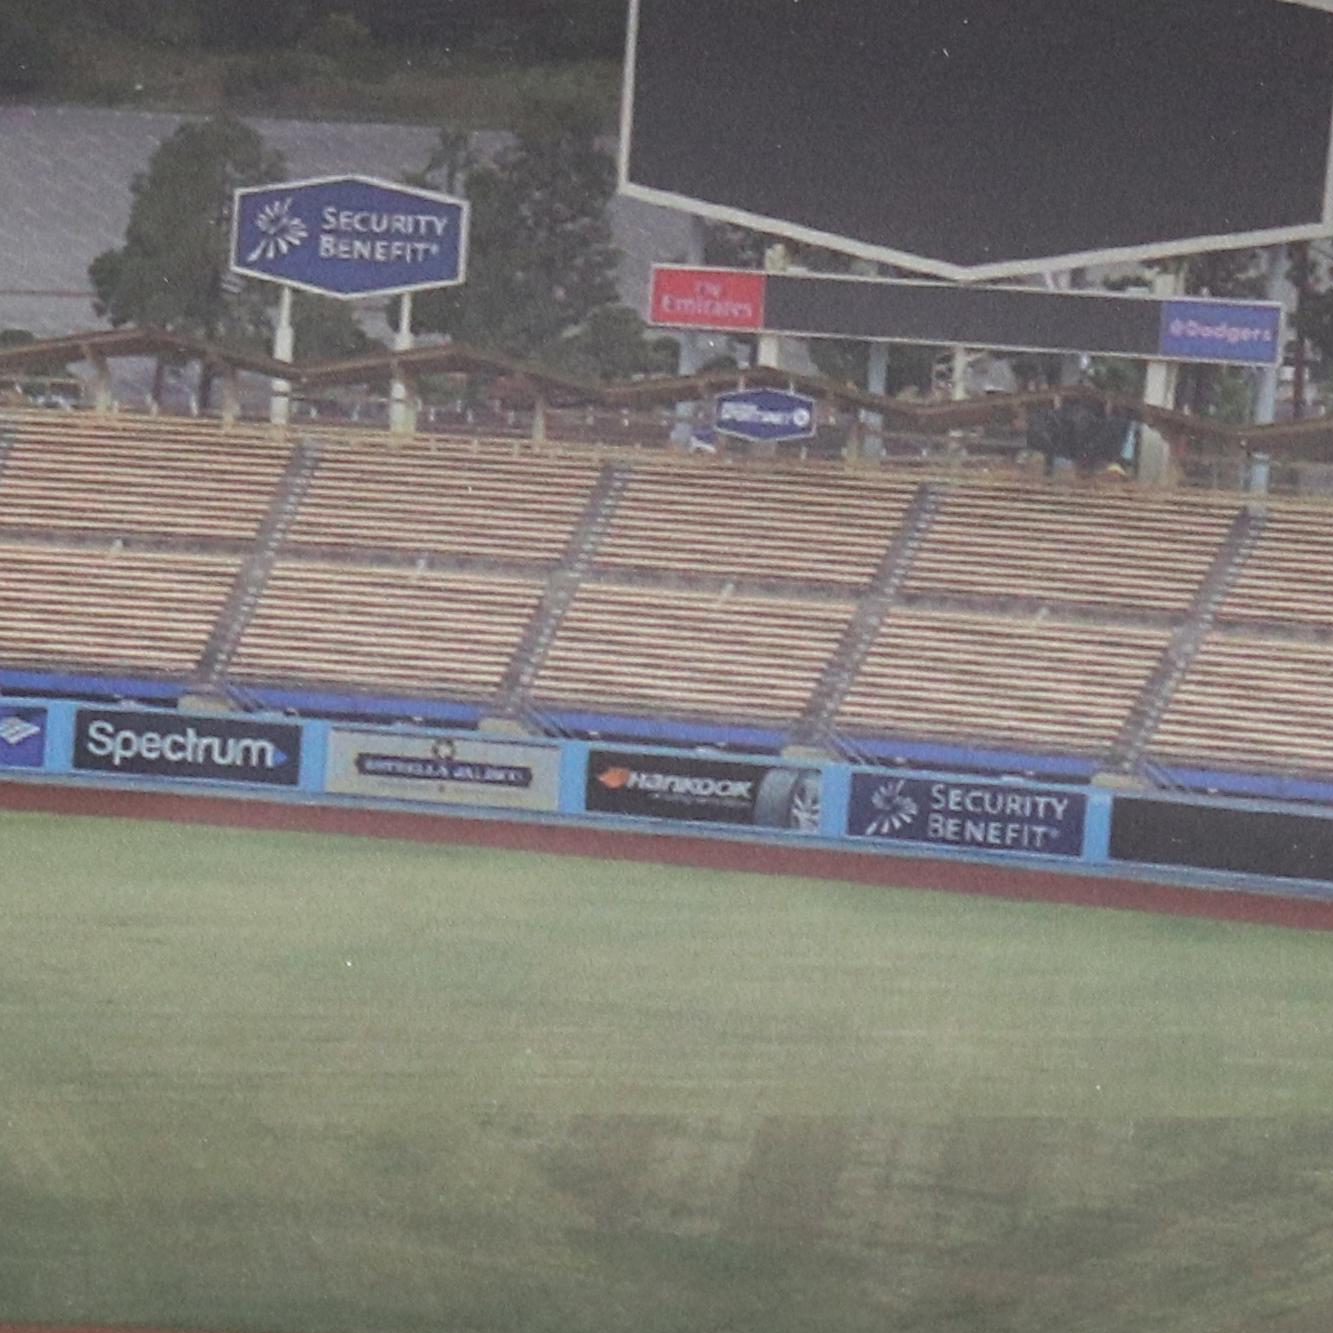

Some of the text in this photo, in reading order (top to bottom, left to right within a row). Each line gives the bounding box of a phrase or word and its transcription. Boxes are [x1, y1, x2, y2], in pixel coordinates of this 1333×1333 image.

[321, 206, 448, 237] SECURITY
[86, 719, 276, 769] Spectrum
[931, 782, 1068, 821] SECURITY
